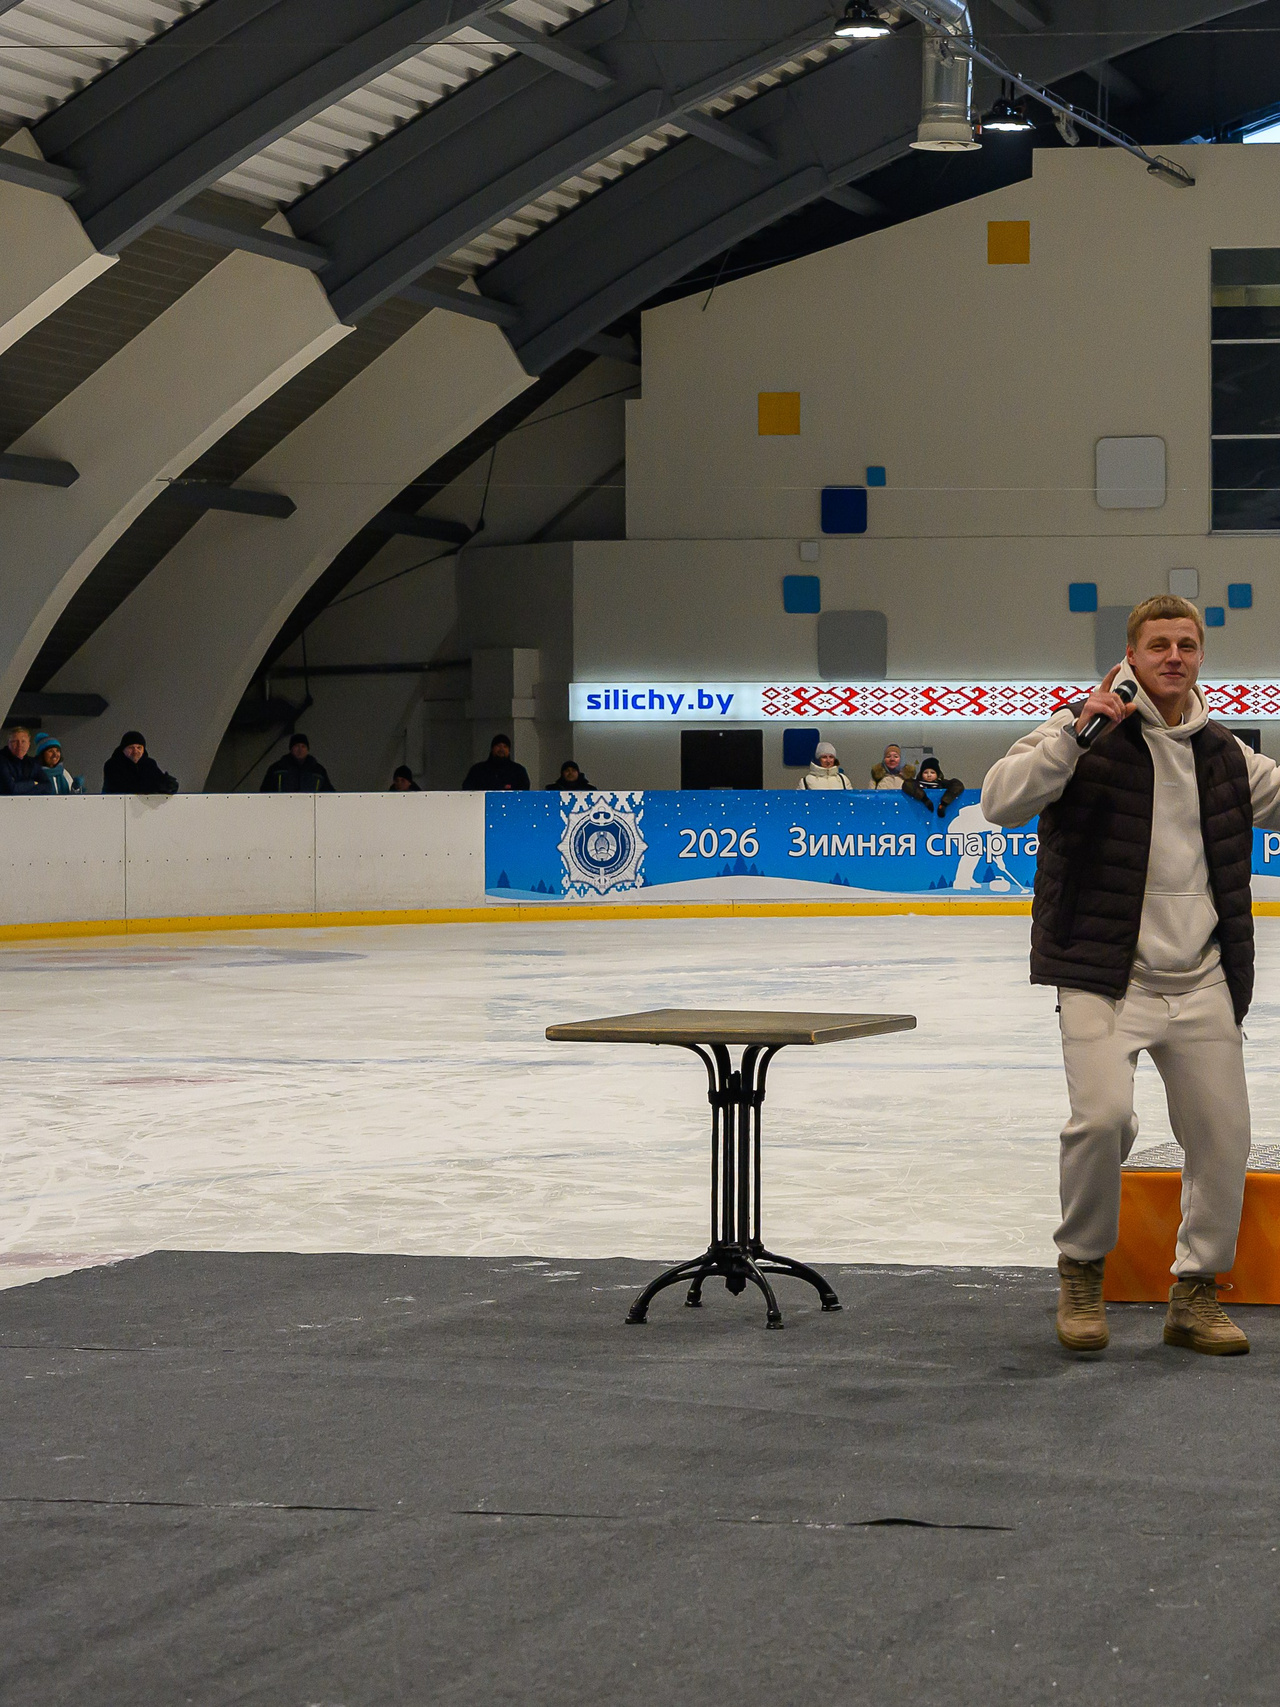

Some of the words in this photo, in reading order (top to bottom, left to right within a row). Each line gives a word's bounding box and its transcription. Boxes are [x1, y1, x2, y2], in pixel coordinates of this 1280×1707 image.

[587, 689, 734, 714] silichy.by
[679, 827, 759, 858] 2026
[788, 826, 916, 858] Зимняя
[925, 832, 1039, 863] спарта
